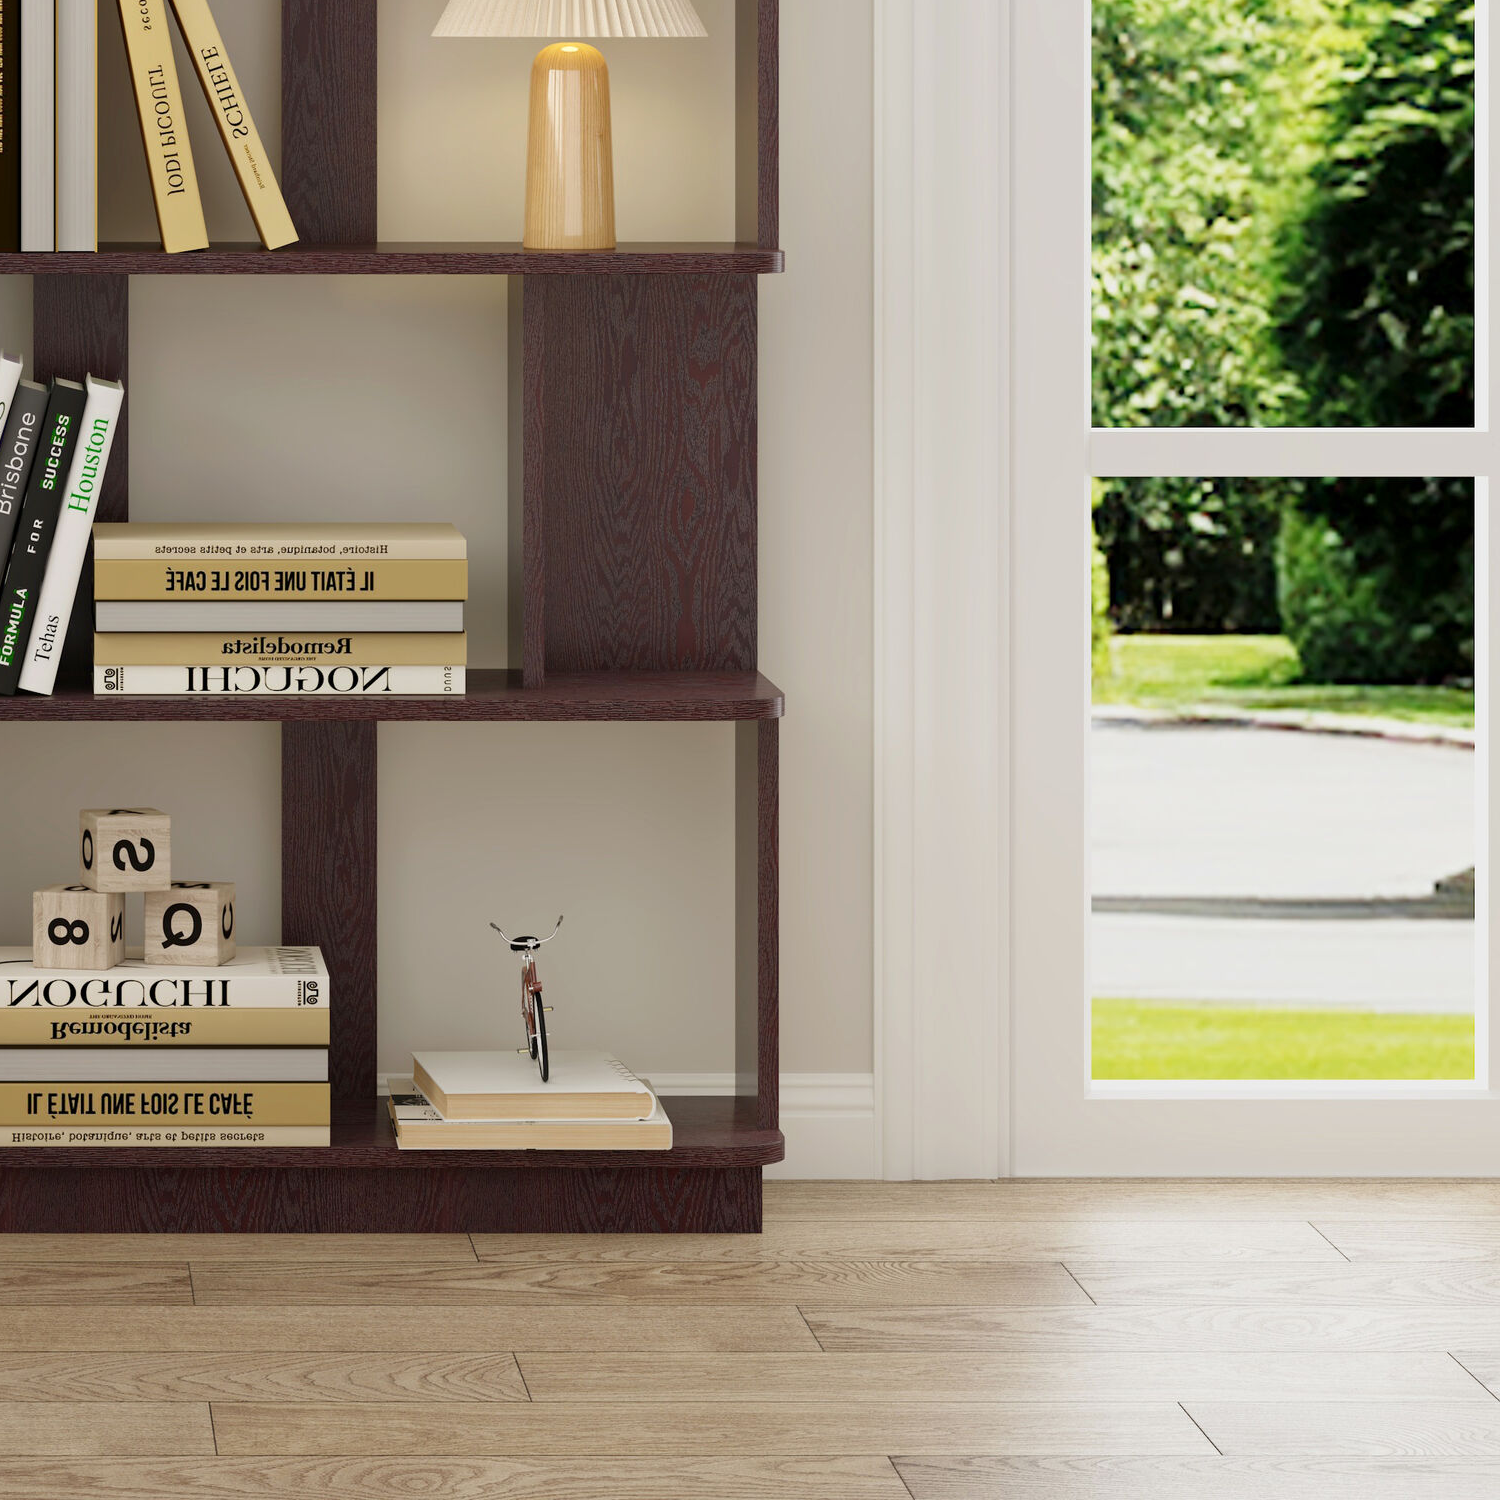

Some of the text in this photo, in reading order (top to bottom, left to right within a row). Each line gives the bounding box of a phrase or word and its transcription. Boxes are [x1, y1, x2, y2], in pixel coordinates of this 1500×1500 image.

[27, 518, 45, 555] FOR
[40, 413, 72, 491] SUCCESS
[67, 417, 110, 515] Houston
[33, 614, 60, 664] Tehas
